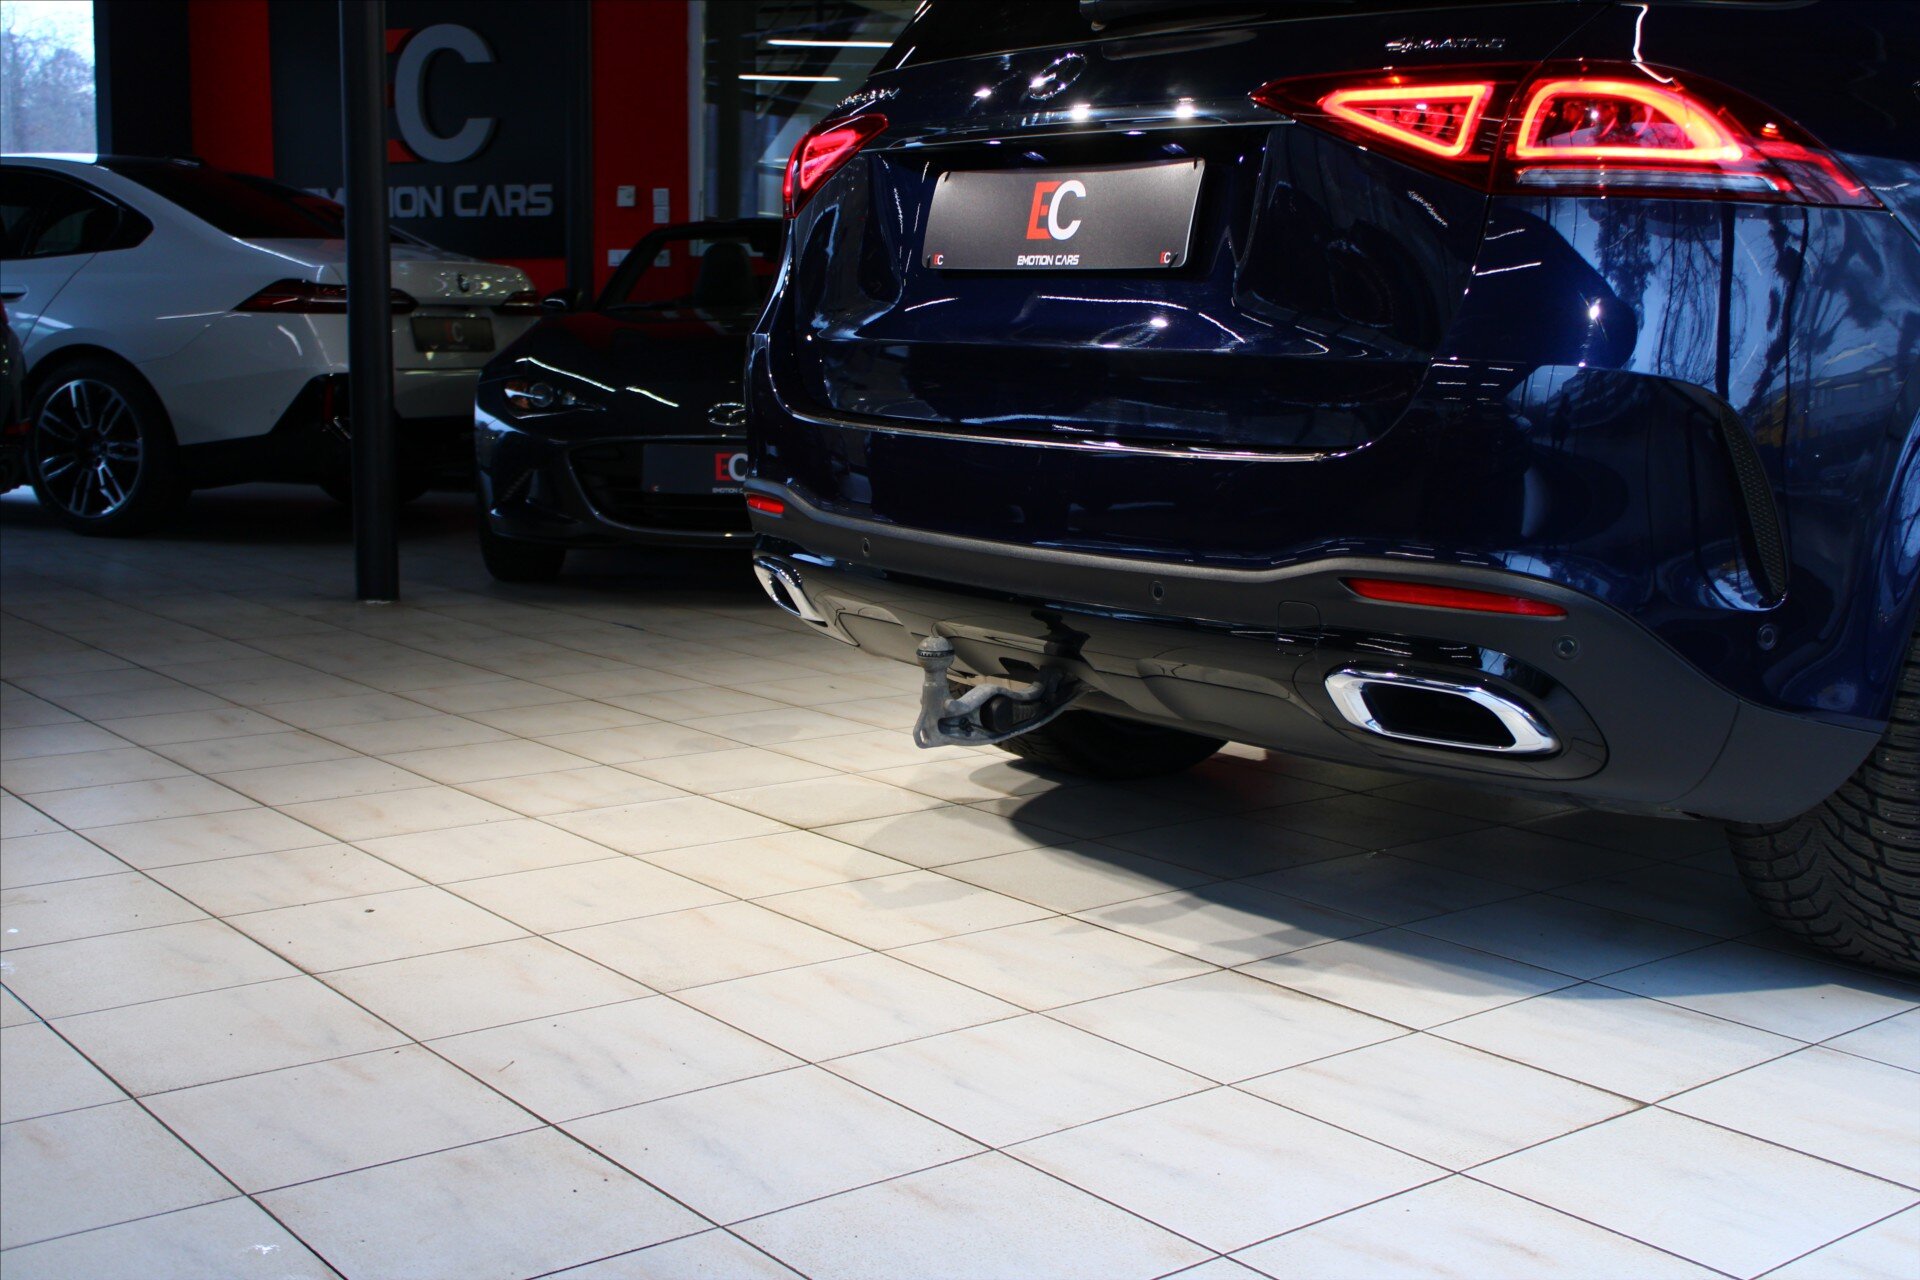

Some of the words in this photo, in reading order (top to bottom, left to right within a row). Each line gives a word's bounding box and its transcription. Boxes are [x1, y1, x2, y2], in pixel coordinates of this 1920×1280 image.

[453, 184, 554, 217] CARS
[1026, 180, 1086, 240] EC
[1016, 254, 1054, 266] EMOTION
[1054, 254, 1080, 266] CARS
[714, 452, 748, 481] EC
